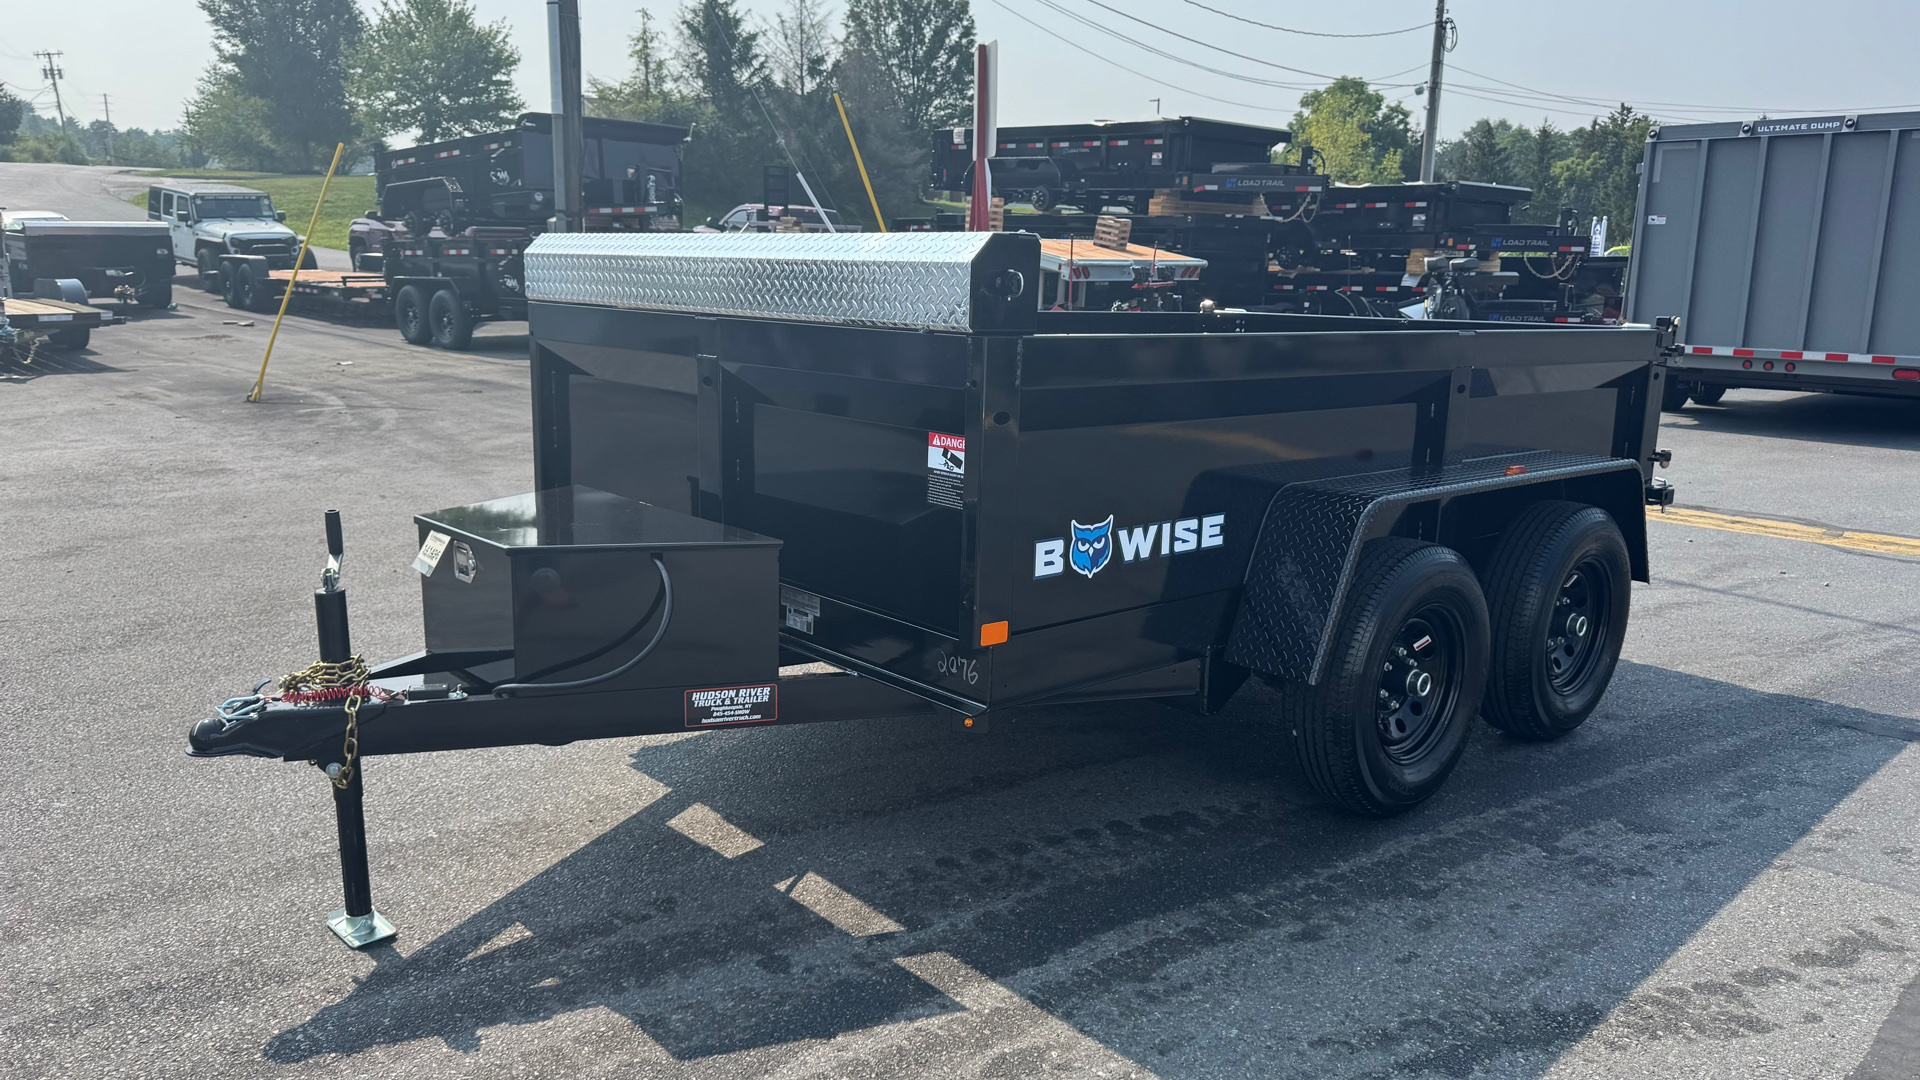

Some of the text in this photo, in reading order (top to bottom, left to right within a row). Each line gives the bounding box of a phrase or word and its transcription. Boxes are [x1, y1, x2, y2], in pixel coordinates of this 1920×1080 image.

[1757, 123, 1807, 132] ULTIMATE
[1117, 513, 1225, 562] WISE
[938, 651, 979, 684] 2076
[692, 687, 770, 700] HUDSON RIVER
[694, 695, 769, 707] TRUCK & TRAILER
